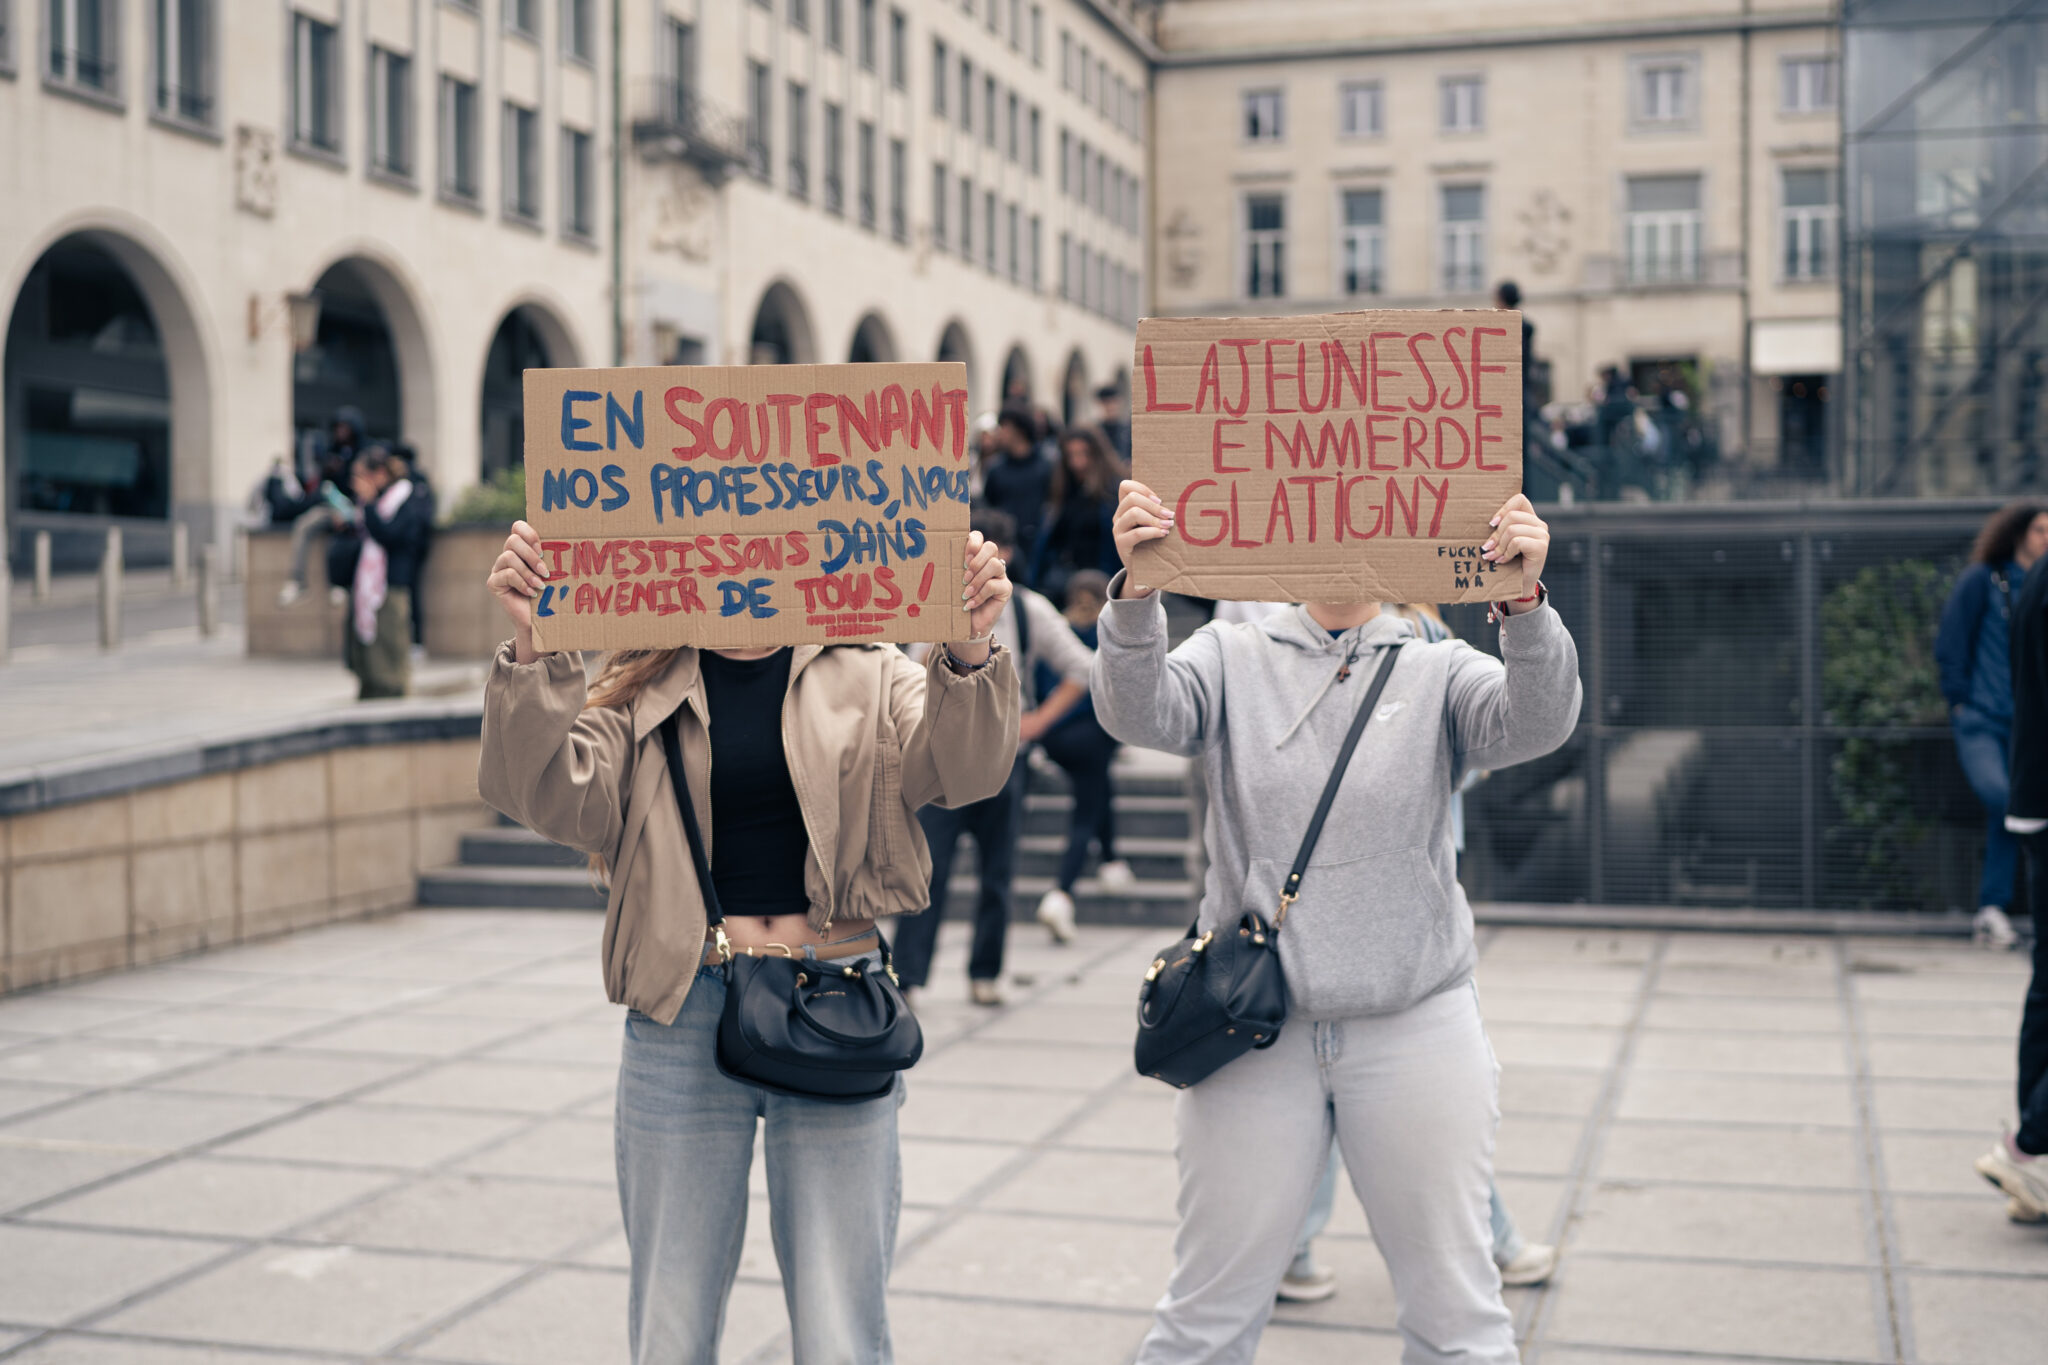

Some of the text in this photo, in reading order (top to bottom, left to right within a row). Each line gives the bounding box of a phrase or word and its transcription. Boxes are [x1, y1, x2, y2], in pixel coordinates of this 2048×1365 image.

[561, 380, 968, 467] EN SOUTENANT
[542, 464, 629, 512] NOS
[901, 464, 970, 511] NOUS
[540, 517, 926, 581] INVESTISSONS DANS
[1438, 546, 1476, 558] FUCK
[536, 576, 707, 618] L'AVENIR
[717, 578, 780, 619] DE
